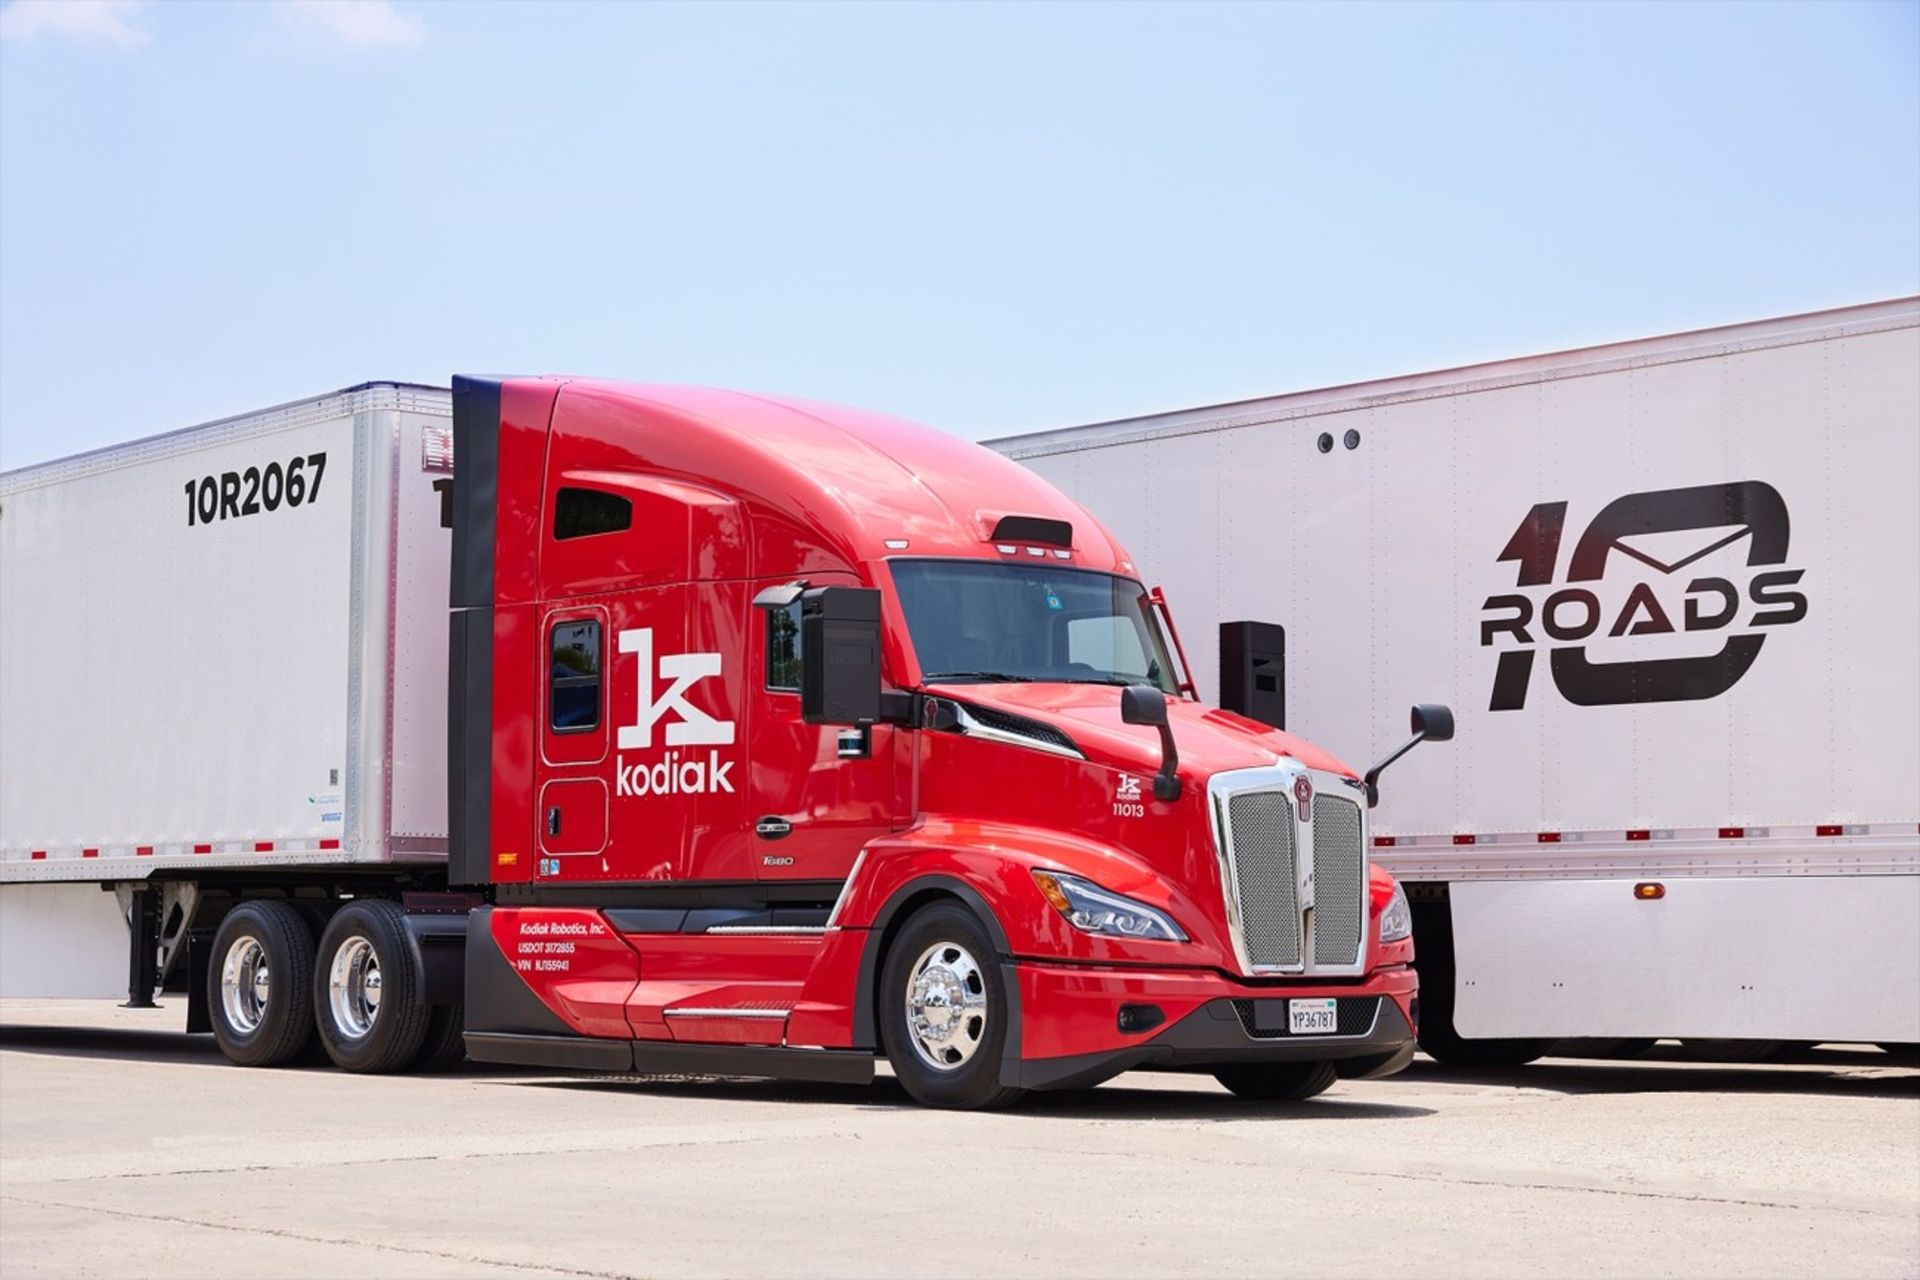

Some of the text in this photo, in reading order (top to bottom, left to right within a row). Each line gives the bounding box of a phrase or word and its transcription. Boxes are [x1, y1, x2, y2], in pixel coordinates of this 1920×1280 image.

[184, 452, 327, 526] 10R2067
[1488, 480, 1790, 712] 10
[1481, 568, 1809, 647] ROADS
[615, 750, 736, 797] kodiak
[1113, 803, 1144, 818] 11013
[520, 922, 605, 936] Kodiak Robotics, Inc.
[518, 942, 544, 953] USDOT
[517, 959, 532, 971] VIN
[1292, 1011, 1334, 1028] YP36787
